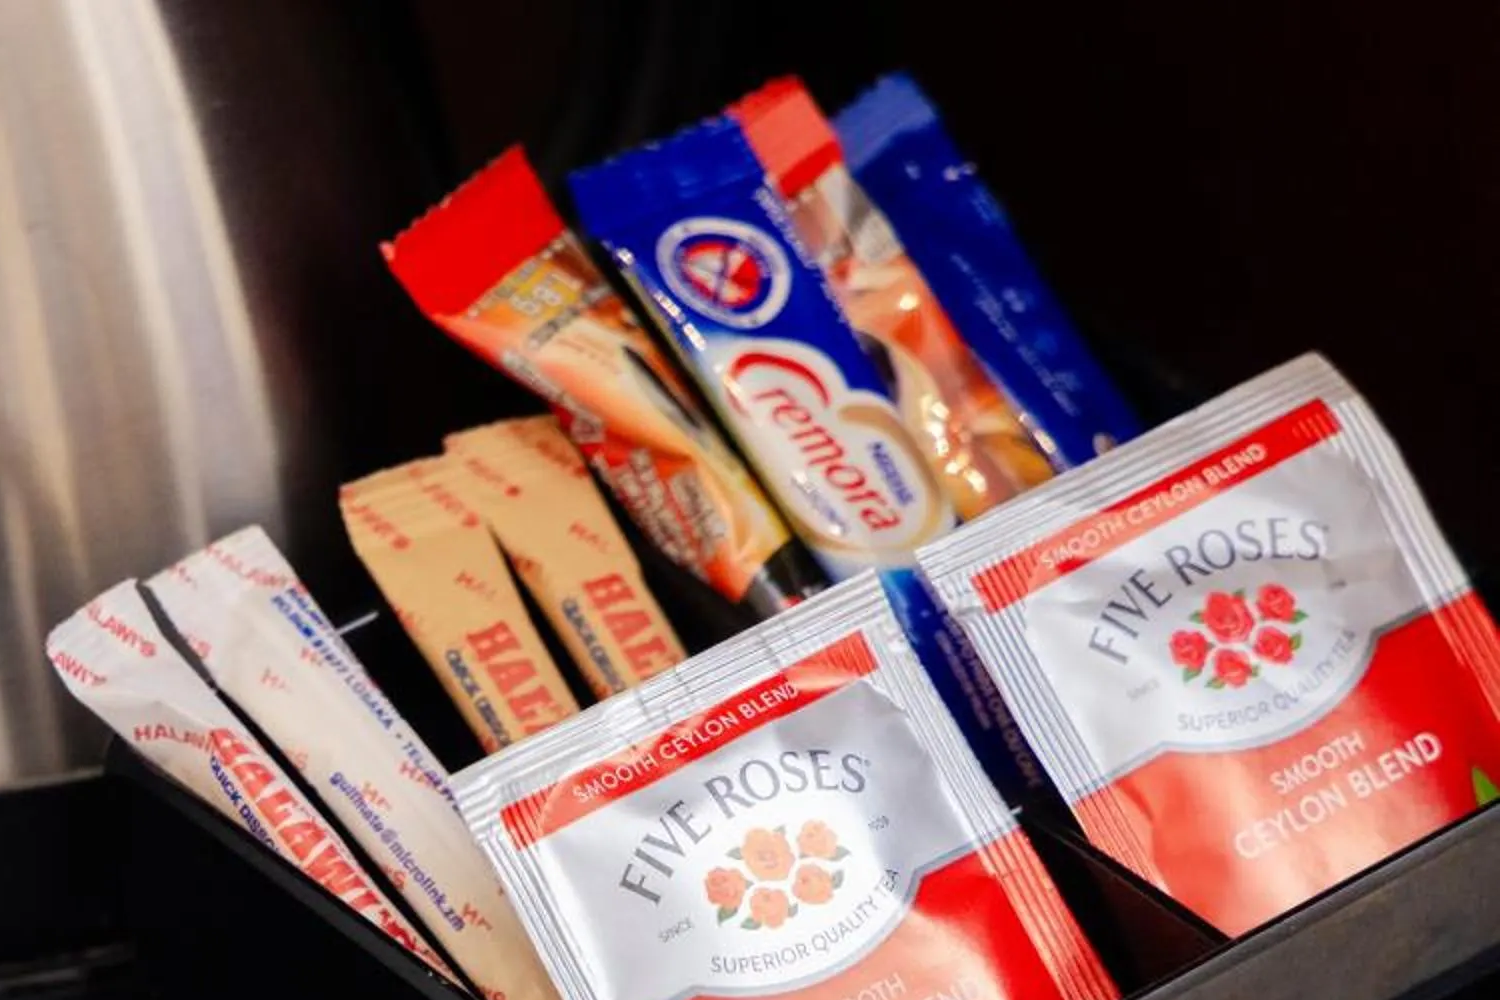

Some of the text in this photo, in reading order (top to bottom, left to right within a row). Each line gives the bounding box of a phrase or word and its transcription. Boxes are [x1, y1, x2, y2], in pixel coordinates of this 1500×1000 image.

[724, 351, 903, 532] Cremora
[1040, 442, 1269, 569] SMOOTH CEYLON BLEND
[581, 572, 674, 680] HAL
[1088, 516, 1324, 666] FIVE ROSES
[572, 681, 799, 803] SMOOTH CEYLON BLEND
[1177, 698, 1270, 733] SUPERIOR
[1272, 658, 1339, 712] QUALITY
[209, 755, 243, 806] QUICK
[1234, 731, 1444, 860] CEYLON BLEND
[1269, 731, 1366, 796] SMOOTH
[619, 748, 867, 906] FIVE ROSES
[710, 867, 901, 975] SUPERIOR QUALITY TEA
